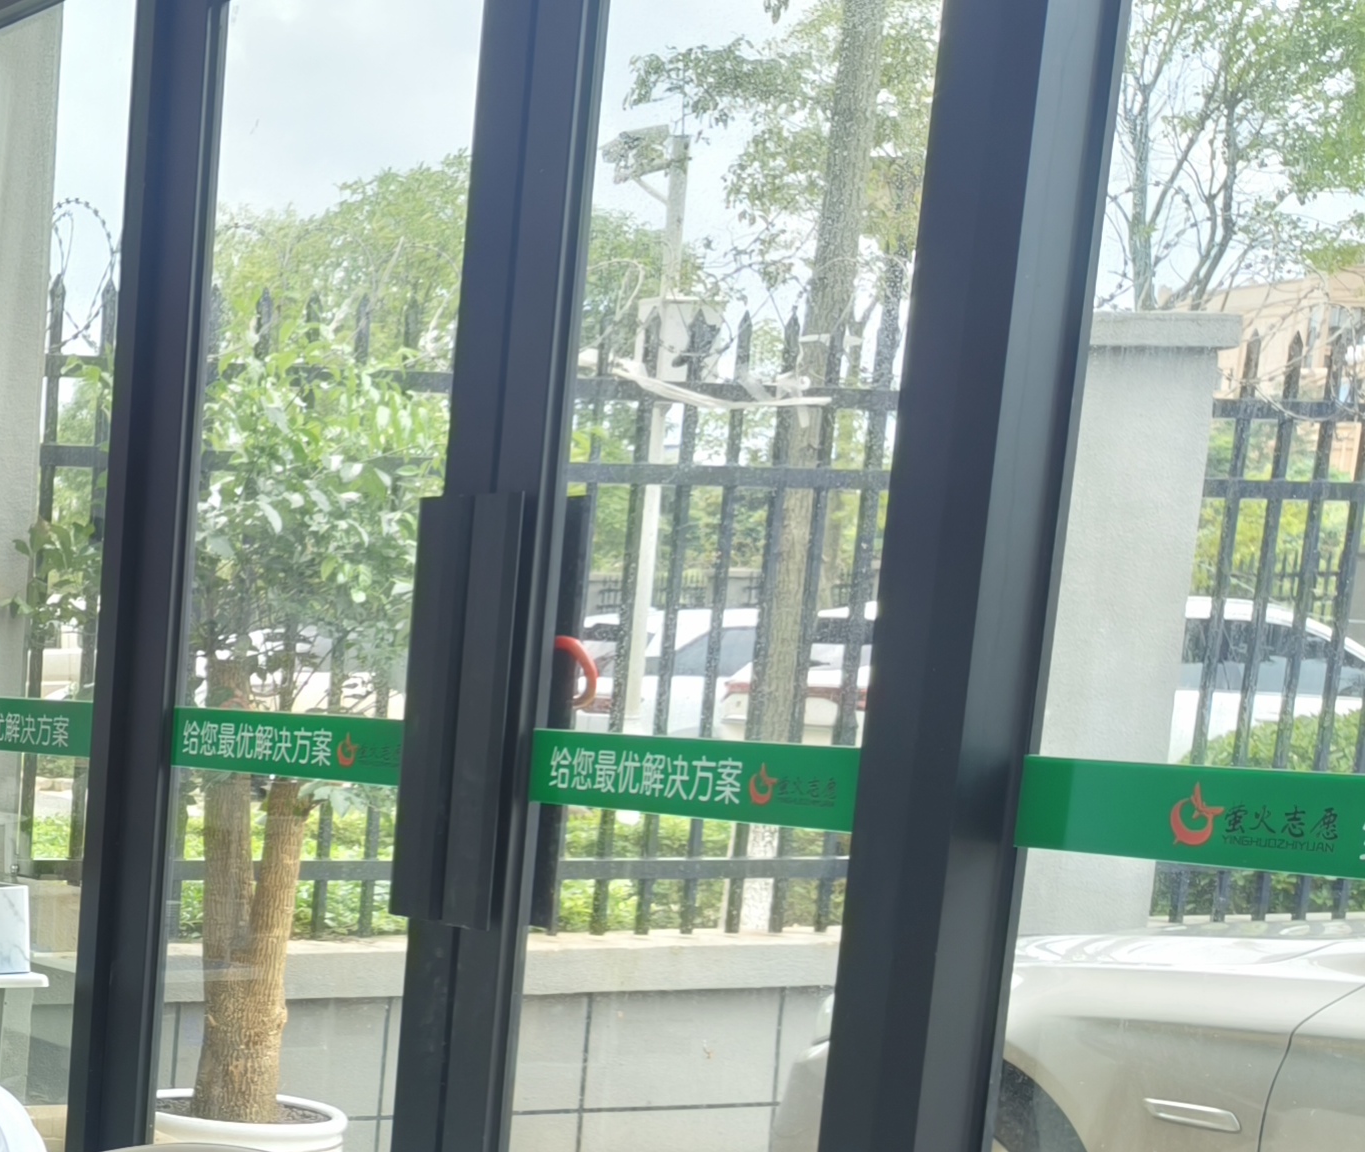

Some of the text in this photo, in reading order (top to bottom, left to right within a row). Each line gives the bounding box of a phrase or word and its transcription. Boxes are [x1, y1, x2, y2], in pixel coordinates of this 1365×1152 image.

[182, 719, 332, 767] 给您最优解决方案
[548, 746, 743, 804] 给您最优解决方案
[1224, 804, 1339, 840] 萤火志愿
[1222, 835, 1335, 853] YINGHUOZHIYUAN
